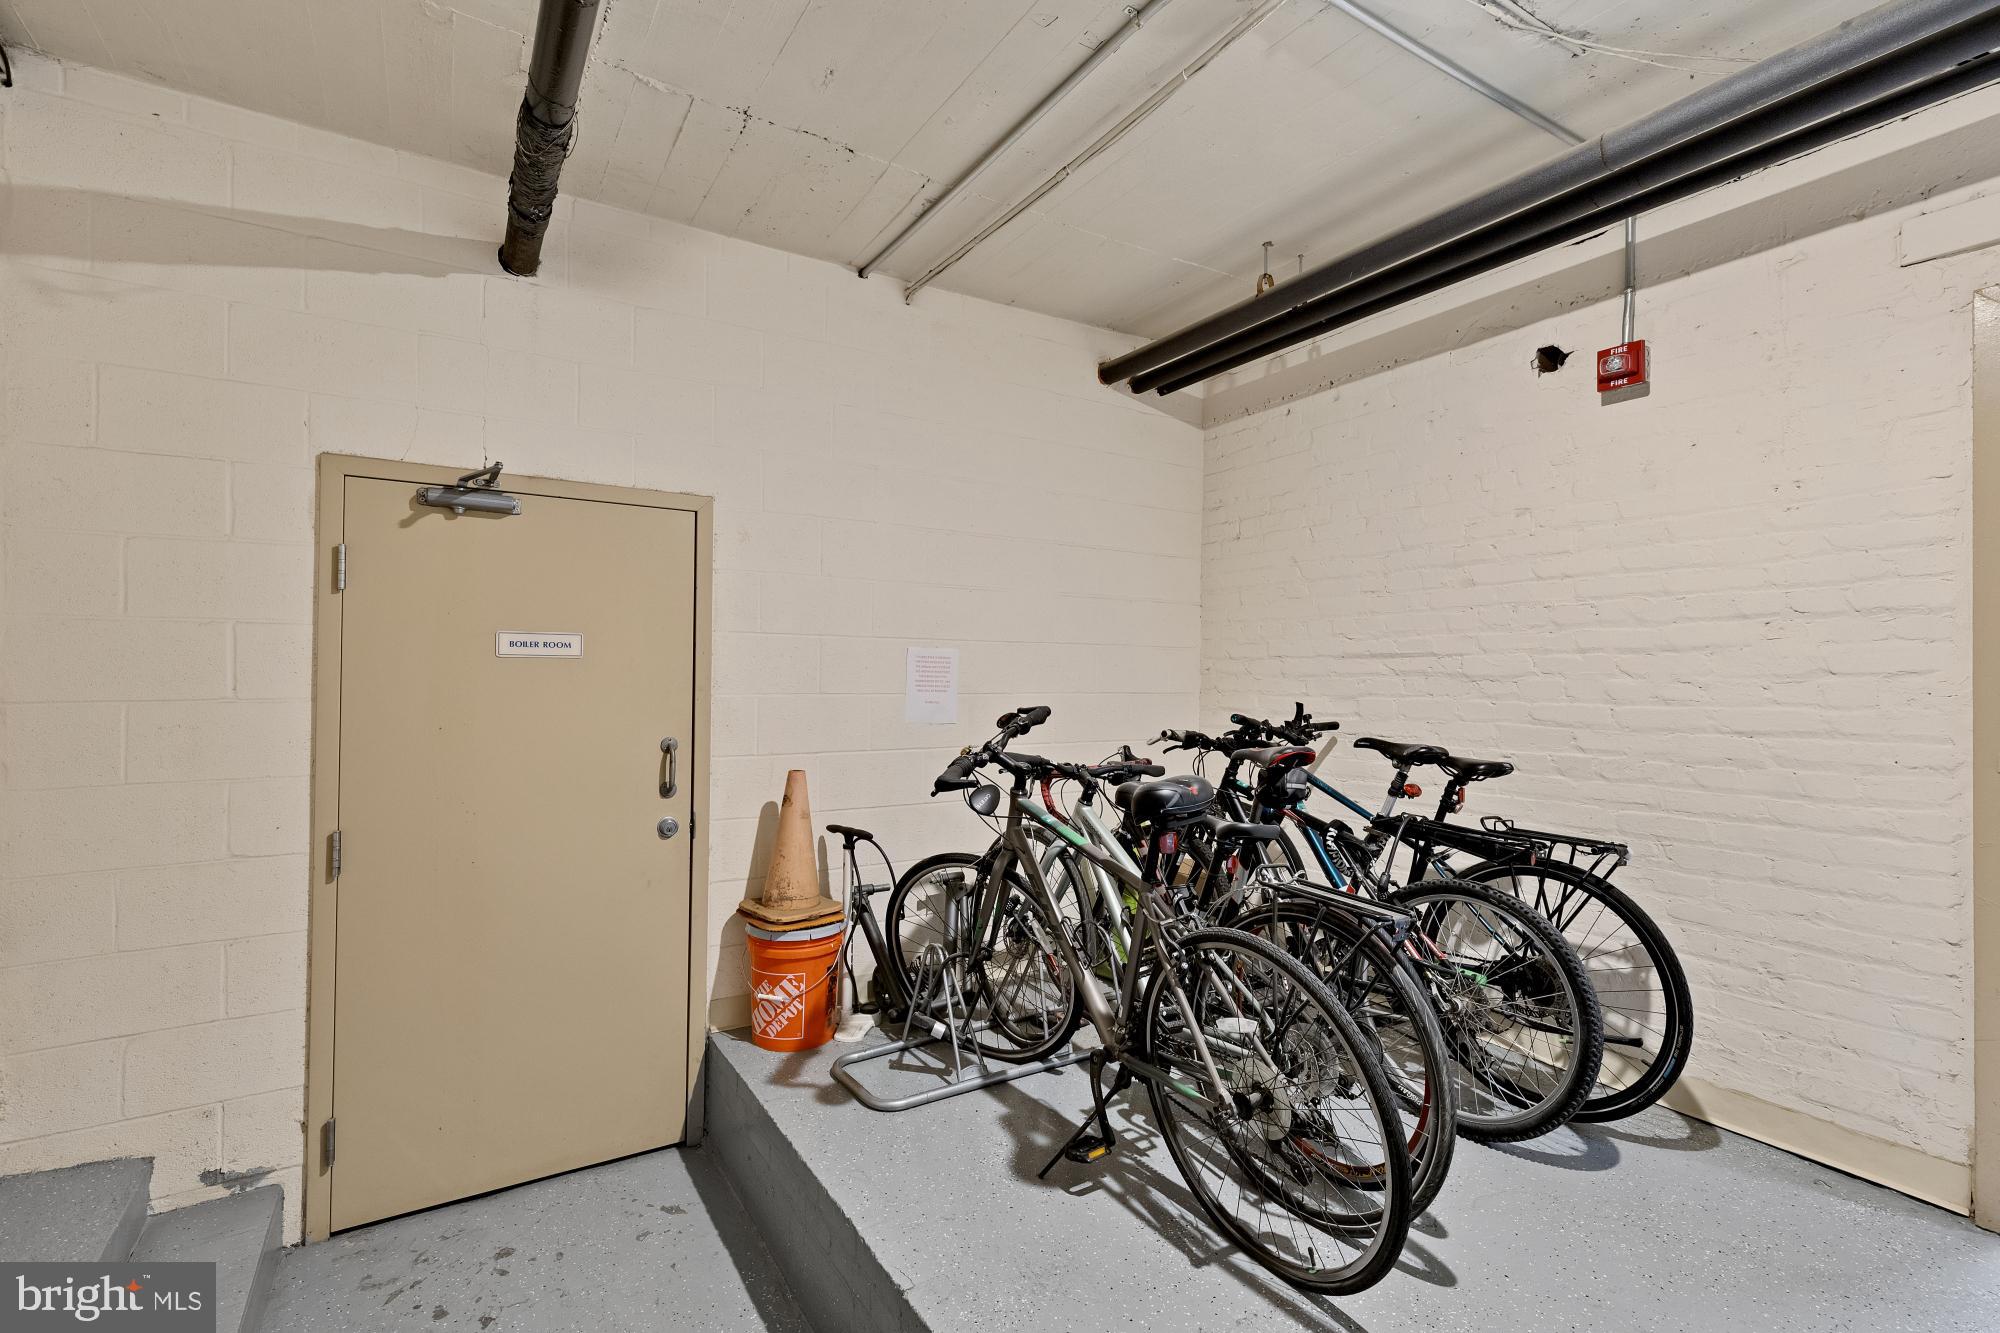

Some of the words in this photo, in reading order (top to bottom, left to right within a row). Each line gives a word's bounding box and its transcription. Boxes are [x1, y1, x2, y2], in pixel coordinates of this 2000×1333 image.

[1610, 345, 1628, 355] FIRE
[1610, 378, 1628, 387] FIRE
[509, 640, 540, 648] BOILER
[542, 641, 572, 649] ROOM
[751, 974, 805, 1035] HOME
[765, 997, 804, 1038] DEPOT
